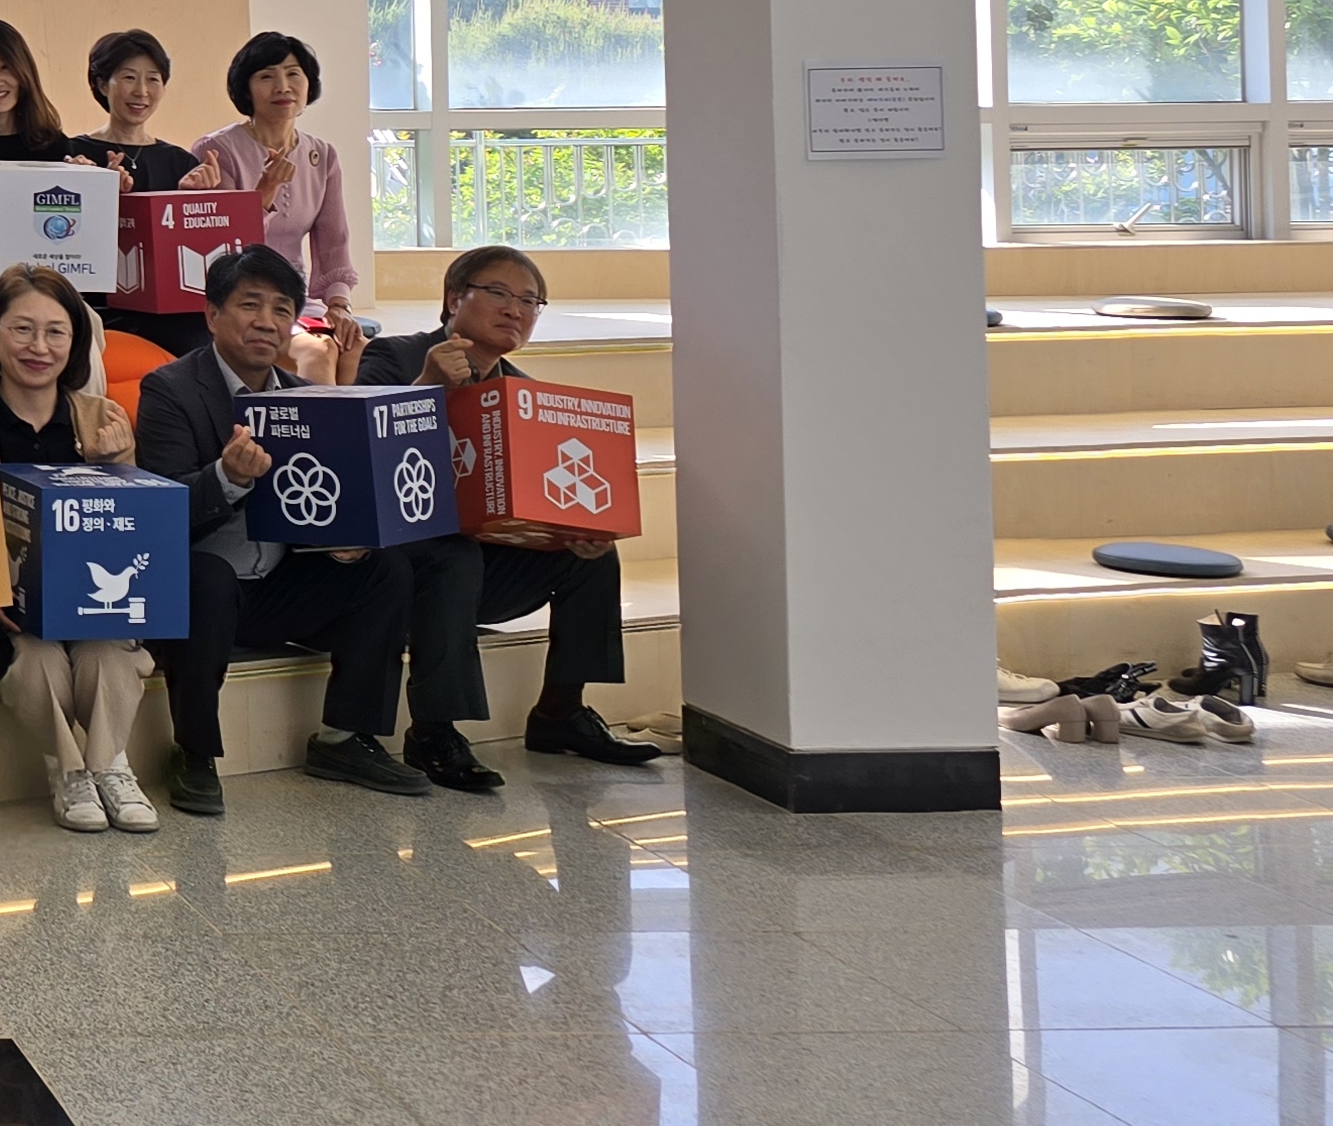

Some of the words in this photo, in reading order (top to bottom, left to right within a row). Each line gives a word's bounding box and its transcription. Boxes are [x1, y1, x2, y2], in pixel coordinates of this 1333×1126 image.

[36, 193, 80, 206] GIMFL
[161, 203, 175, 229] 4
[182, 202, 218, 216] QUALITY
[183, 216, 230, 229] EDUCATION
[58, 262, 96, 275] GIMFL
[480, 390, 500, 408] 9
[517, 389, 533, 420] 9
[269, 406, 299, 421] 글로벌
[581, 400, 631, 420] INNOVATION
[244, 406, 267, 438] 17
[373, 405, 388, 438] 17
[481, 414, 491, 433] AND
[538, 409, 557, 424] AND
[557, 412, 631, 436] INFRASTRUCTURE
[270, 425, 311, 439] 파트너십
[82, 498, 115, 513] 평화와
[52, 499, 80, 532] 16
